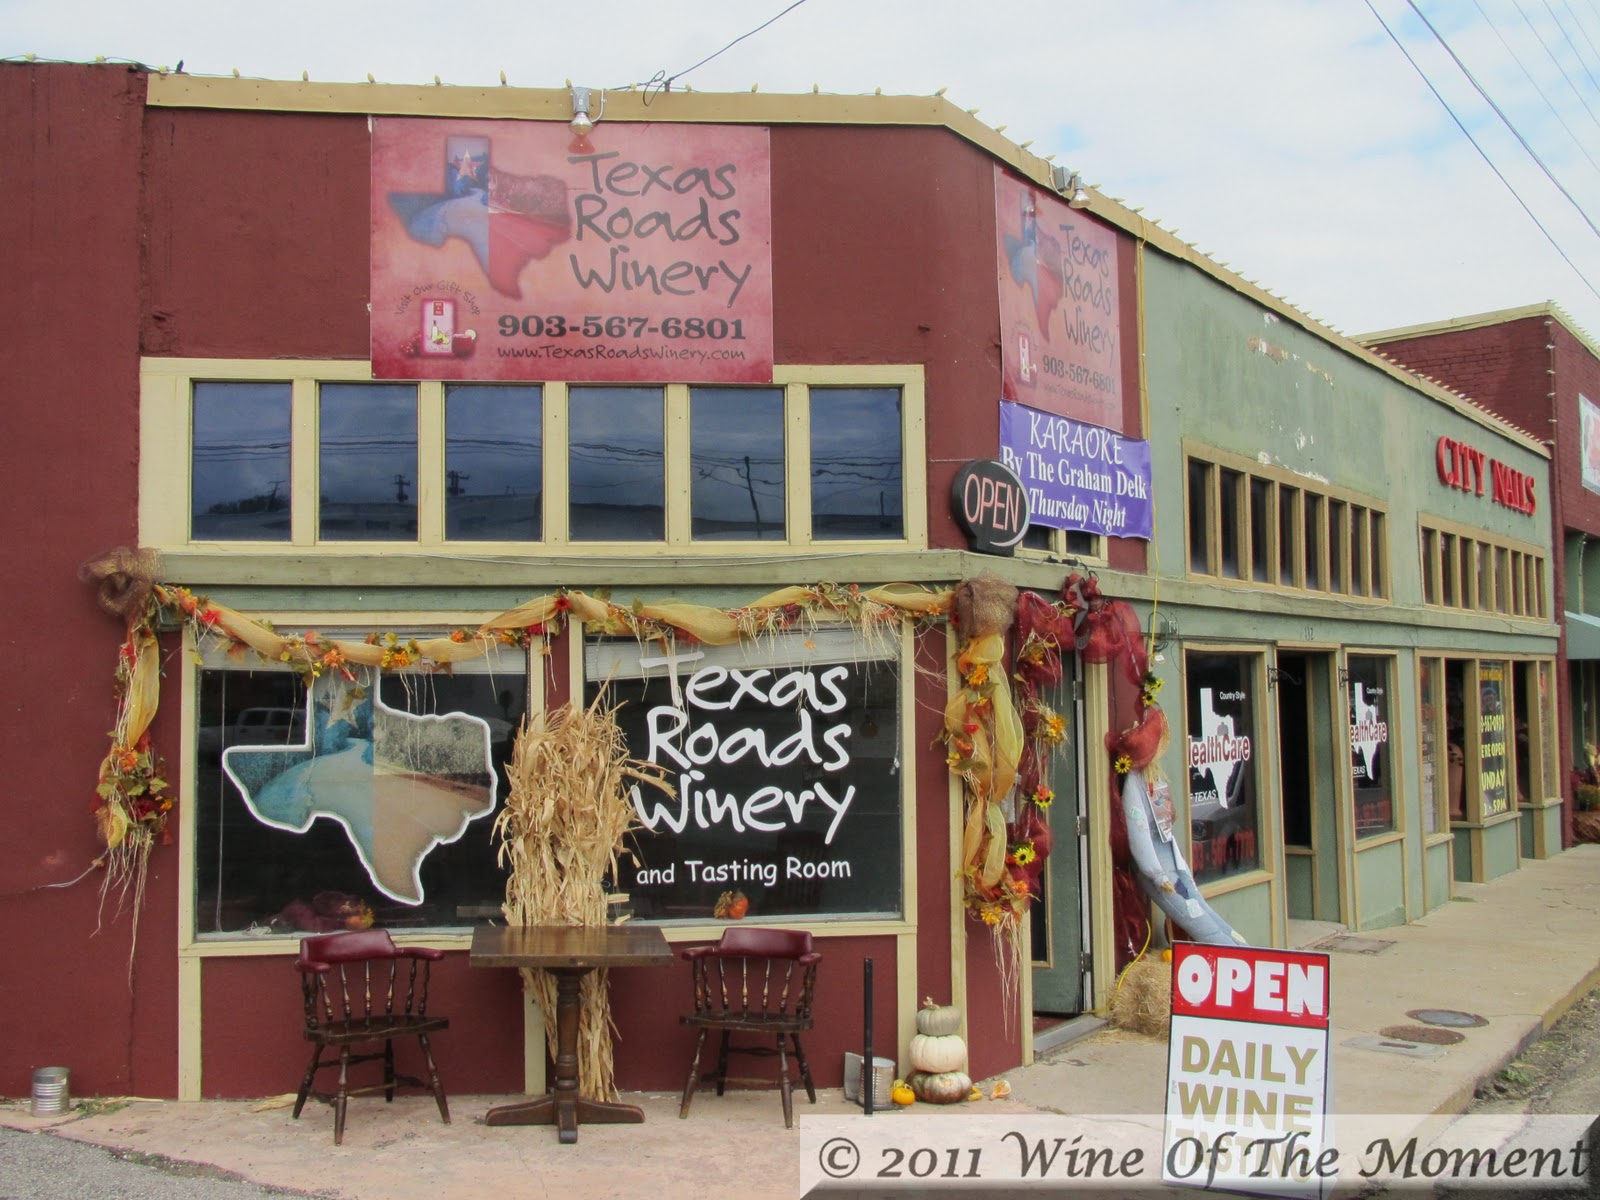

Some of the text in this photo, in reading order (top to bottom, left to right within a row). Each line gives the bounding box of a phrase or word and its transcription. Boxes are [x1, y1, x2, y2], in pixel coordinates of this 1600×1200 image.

[567, 151, 737, 200] Texas
[575, 194, 741, 246] Roads
[570, 244, 752, 308] Winery
[1059, 224, 1109, 279] Texas
[395, 294, 412, 315] Visit
[413, 284, 433, 296] Our
[437, 280, 461, 293] Gift
[463, 291, 481, 315] Shop
[1063, 258, 1112, 316] Roads
[498, 314, 746, 340] 903-567-6801
[1064, 305, 1116, 368] Winery
[497, 344, 746, 364] www.TexasRoadsWinery.com
[1042, 354, 1116, 395] 903-567-6801
[1028, 411, 1124, 465] KARAOKE
[1001, 445, 1148, 499] By The Graham Delk
[1436, 435, 1536, 516] CITY NAILS
[964, 473, 1020, 533] OPEN
[1029, 487, 1126, 532] Thursday Night
[639, 651, 849, 713] Texas
[1219, 691, 1246, 701] Country Style
[647, 705, 851, 771] Roads
[1350, 720, 1387, 742] ealthCare
[1194, 789, 1217, 803] TEXAS
[1481, 769, 1505, 791] UNDAY
[631, 770, 856, 845] Winery
[636, 856, 851, 887] and Tasting Room
[1177, 954, 1324, 1016] OPEN
[1181, 1035, 1319, 1086] DAILY
[1178, 1081, 1313, 1133] WINE
